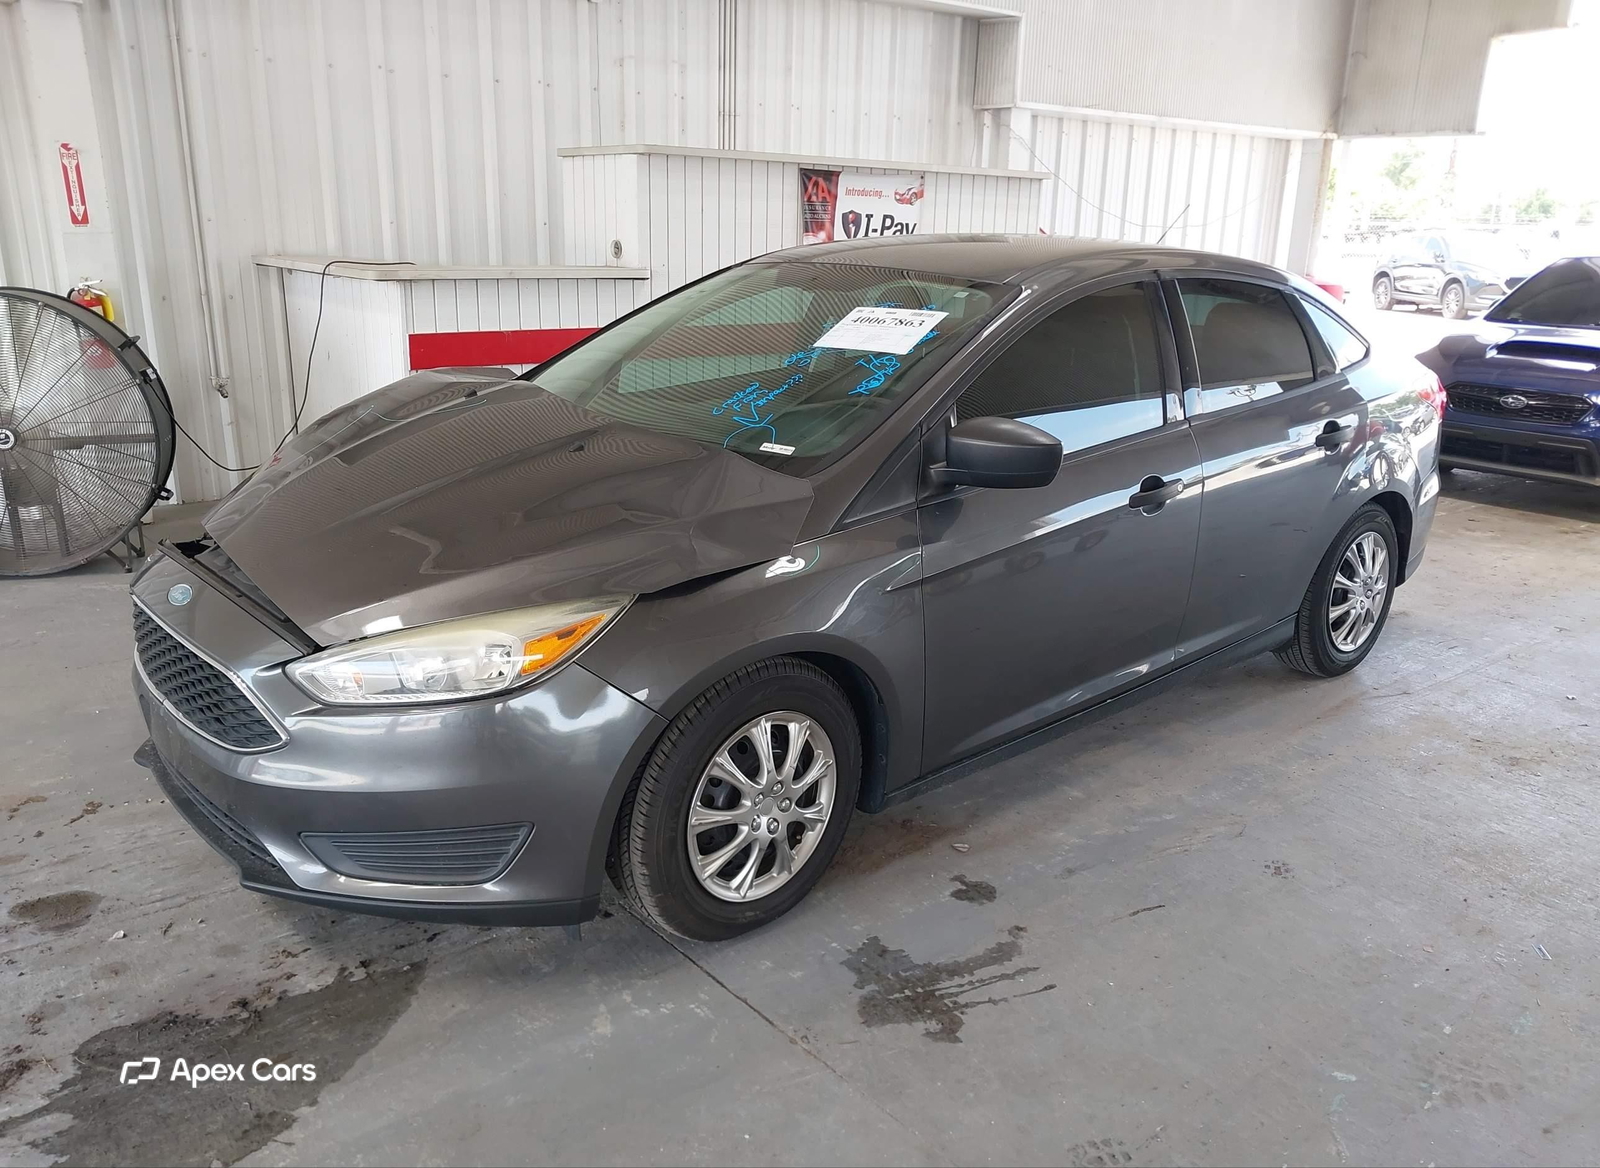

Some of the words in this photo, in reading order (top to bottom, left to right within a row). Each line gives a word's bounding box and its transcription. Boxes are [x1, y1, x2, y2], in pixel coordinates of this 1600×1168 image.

[61, 152, 78, 161] FIRE
[68, 160, 82, 218] EXTINGUISHER
[845, 186, 890, 200] Introducing...
[851, 315, 925, 328] 40067863
